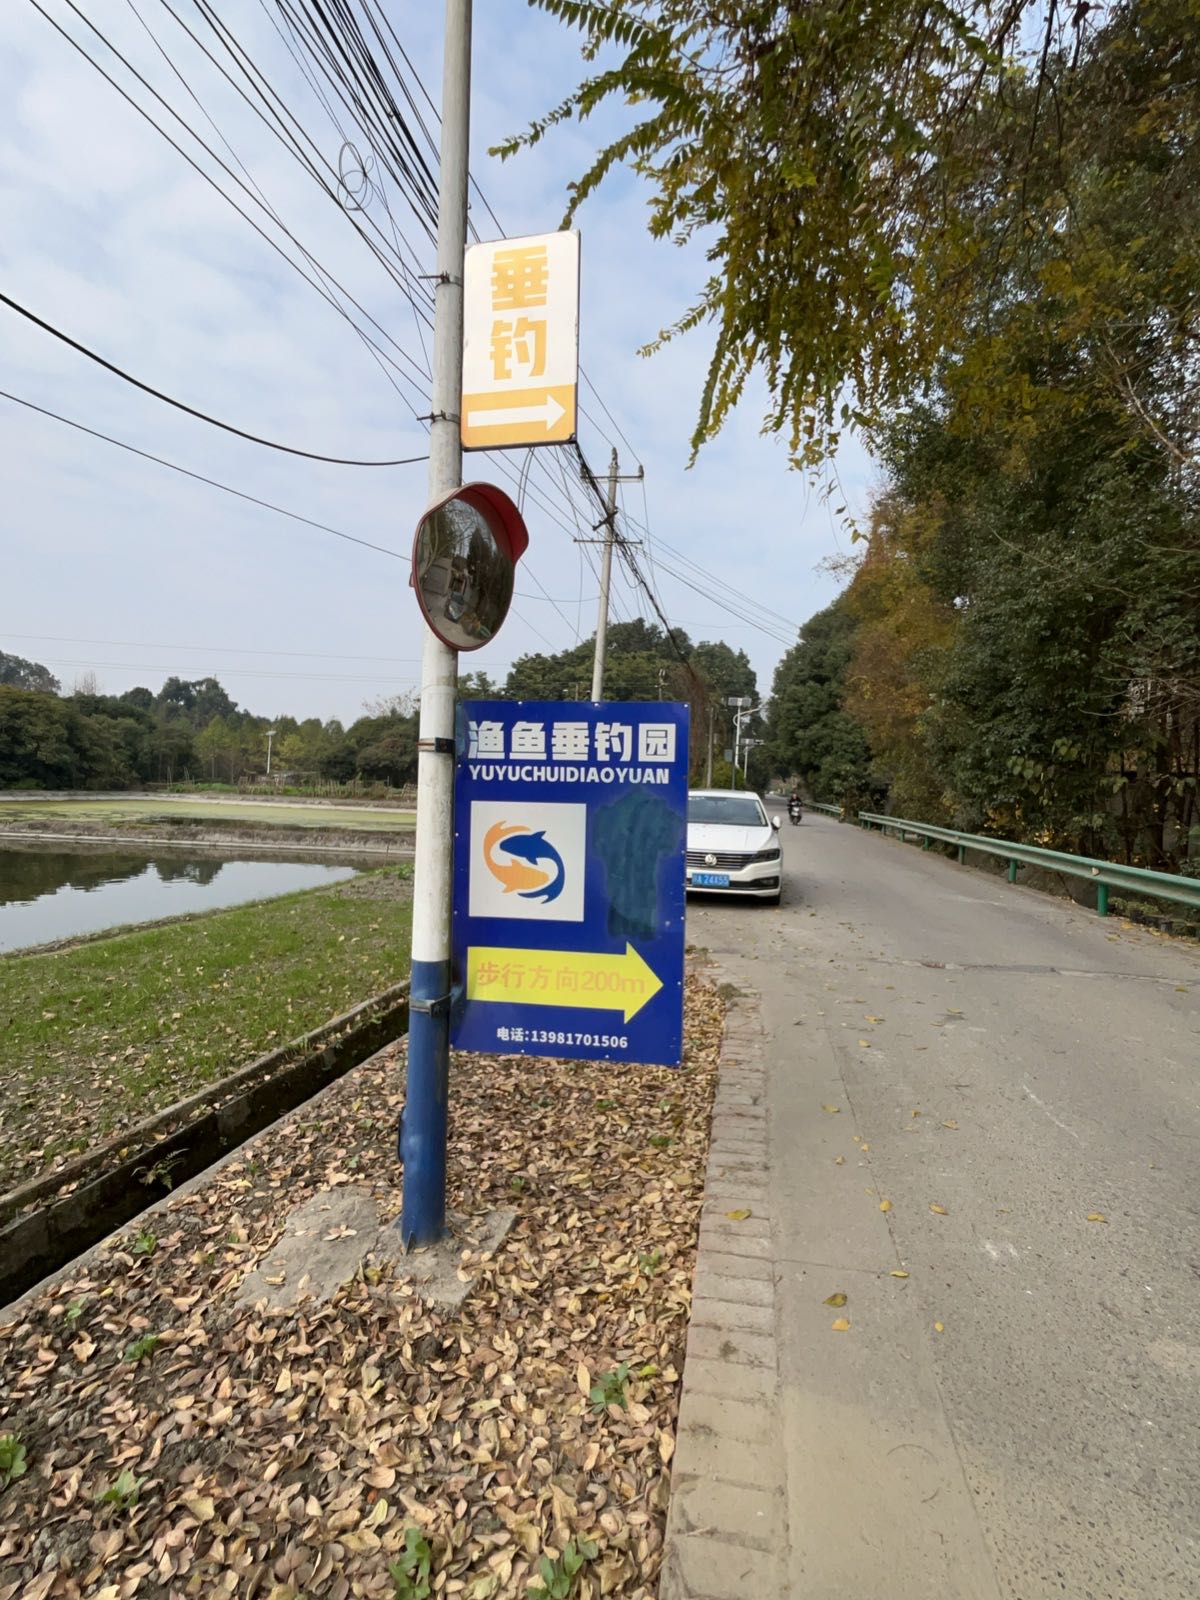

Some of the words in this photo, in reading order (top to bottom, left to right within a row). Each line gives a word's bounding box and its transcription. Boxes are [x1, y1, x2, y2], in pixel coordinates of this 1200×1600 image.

[490, 244, 549, 381] 垂钓
[467, 720, 676, 763] 渔鱼垂钓园
[469, 765, 670, 784] YUYUCHUIDIAOYUAN
[477, 961, 646, 993] 步行方向200m
